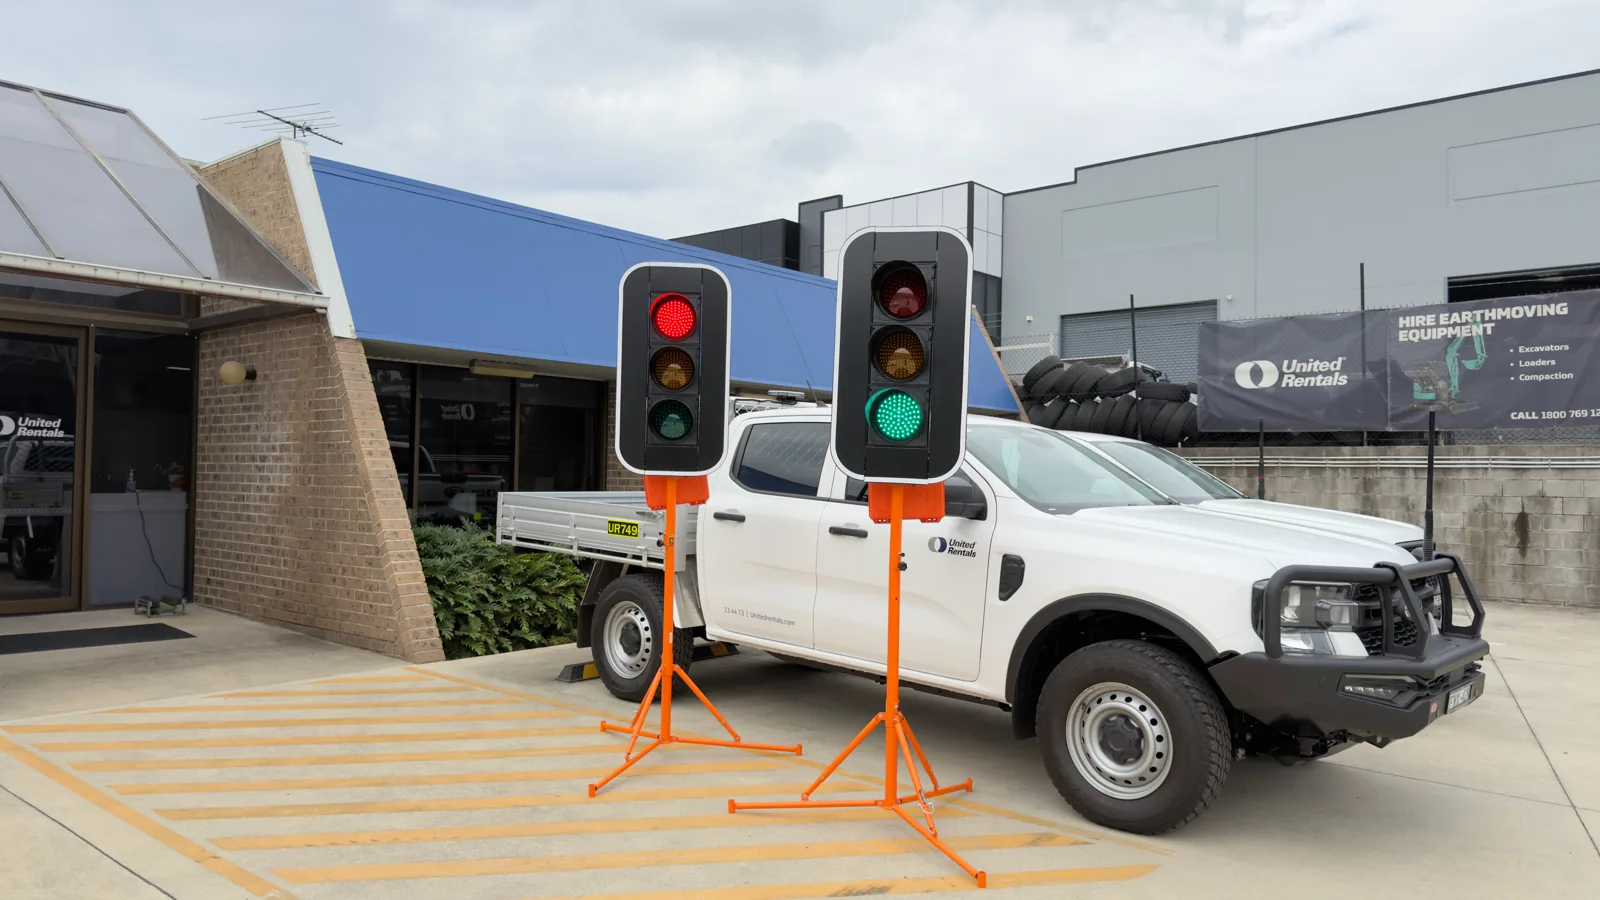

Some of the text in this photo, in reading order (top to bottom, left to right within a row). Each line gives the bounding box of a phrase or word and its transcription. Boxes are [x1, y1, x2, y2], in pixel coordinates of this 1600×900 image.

[1399, 303, 1568, 328] HIRE EARTHMOVING
[1399, 323, 1495, 342] EQUIPMENT
[1518, 344, 1570, 353] Excavators
[1282, 357, 1343, 373] United
[1519, 358, 1556, 367] Loaders
[1281, 372, 1348, 388] Rentals
[1519, 372, 1574, 382] Compaction
[1510, 411, 1539, 420] CALL
[1541, 411, 1567, 419] 1800
[1568, 409, 1588, 418] 769
[18, 416, 62, 428] United
[17, 426, 65, 438] Rentals
[608, 523, 638, 536] UR749
[948, 538, 976, 549] United
[947, 546, 977, 558] Rentals
[749, 611, 796, 626] Unitedrentals.com
